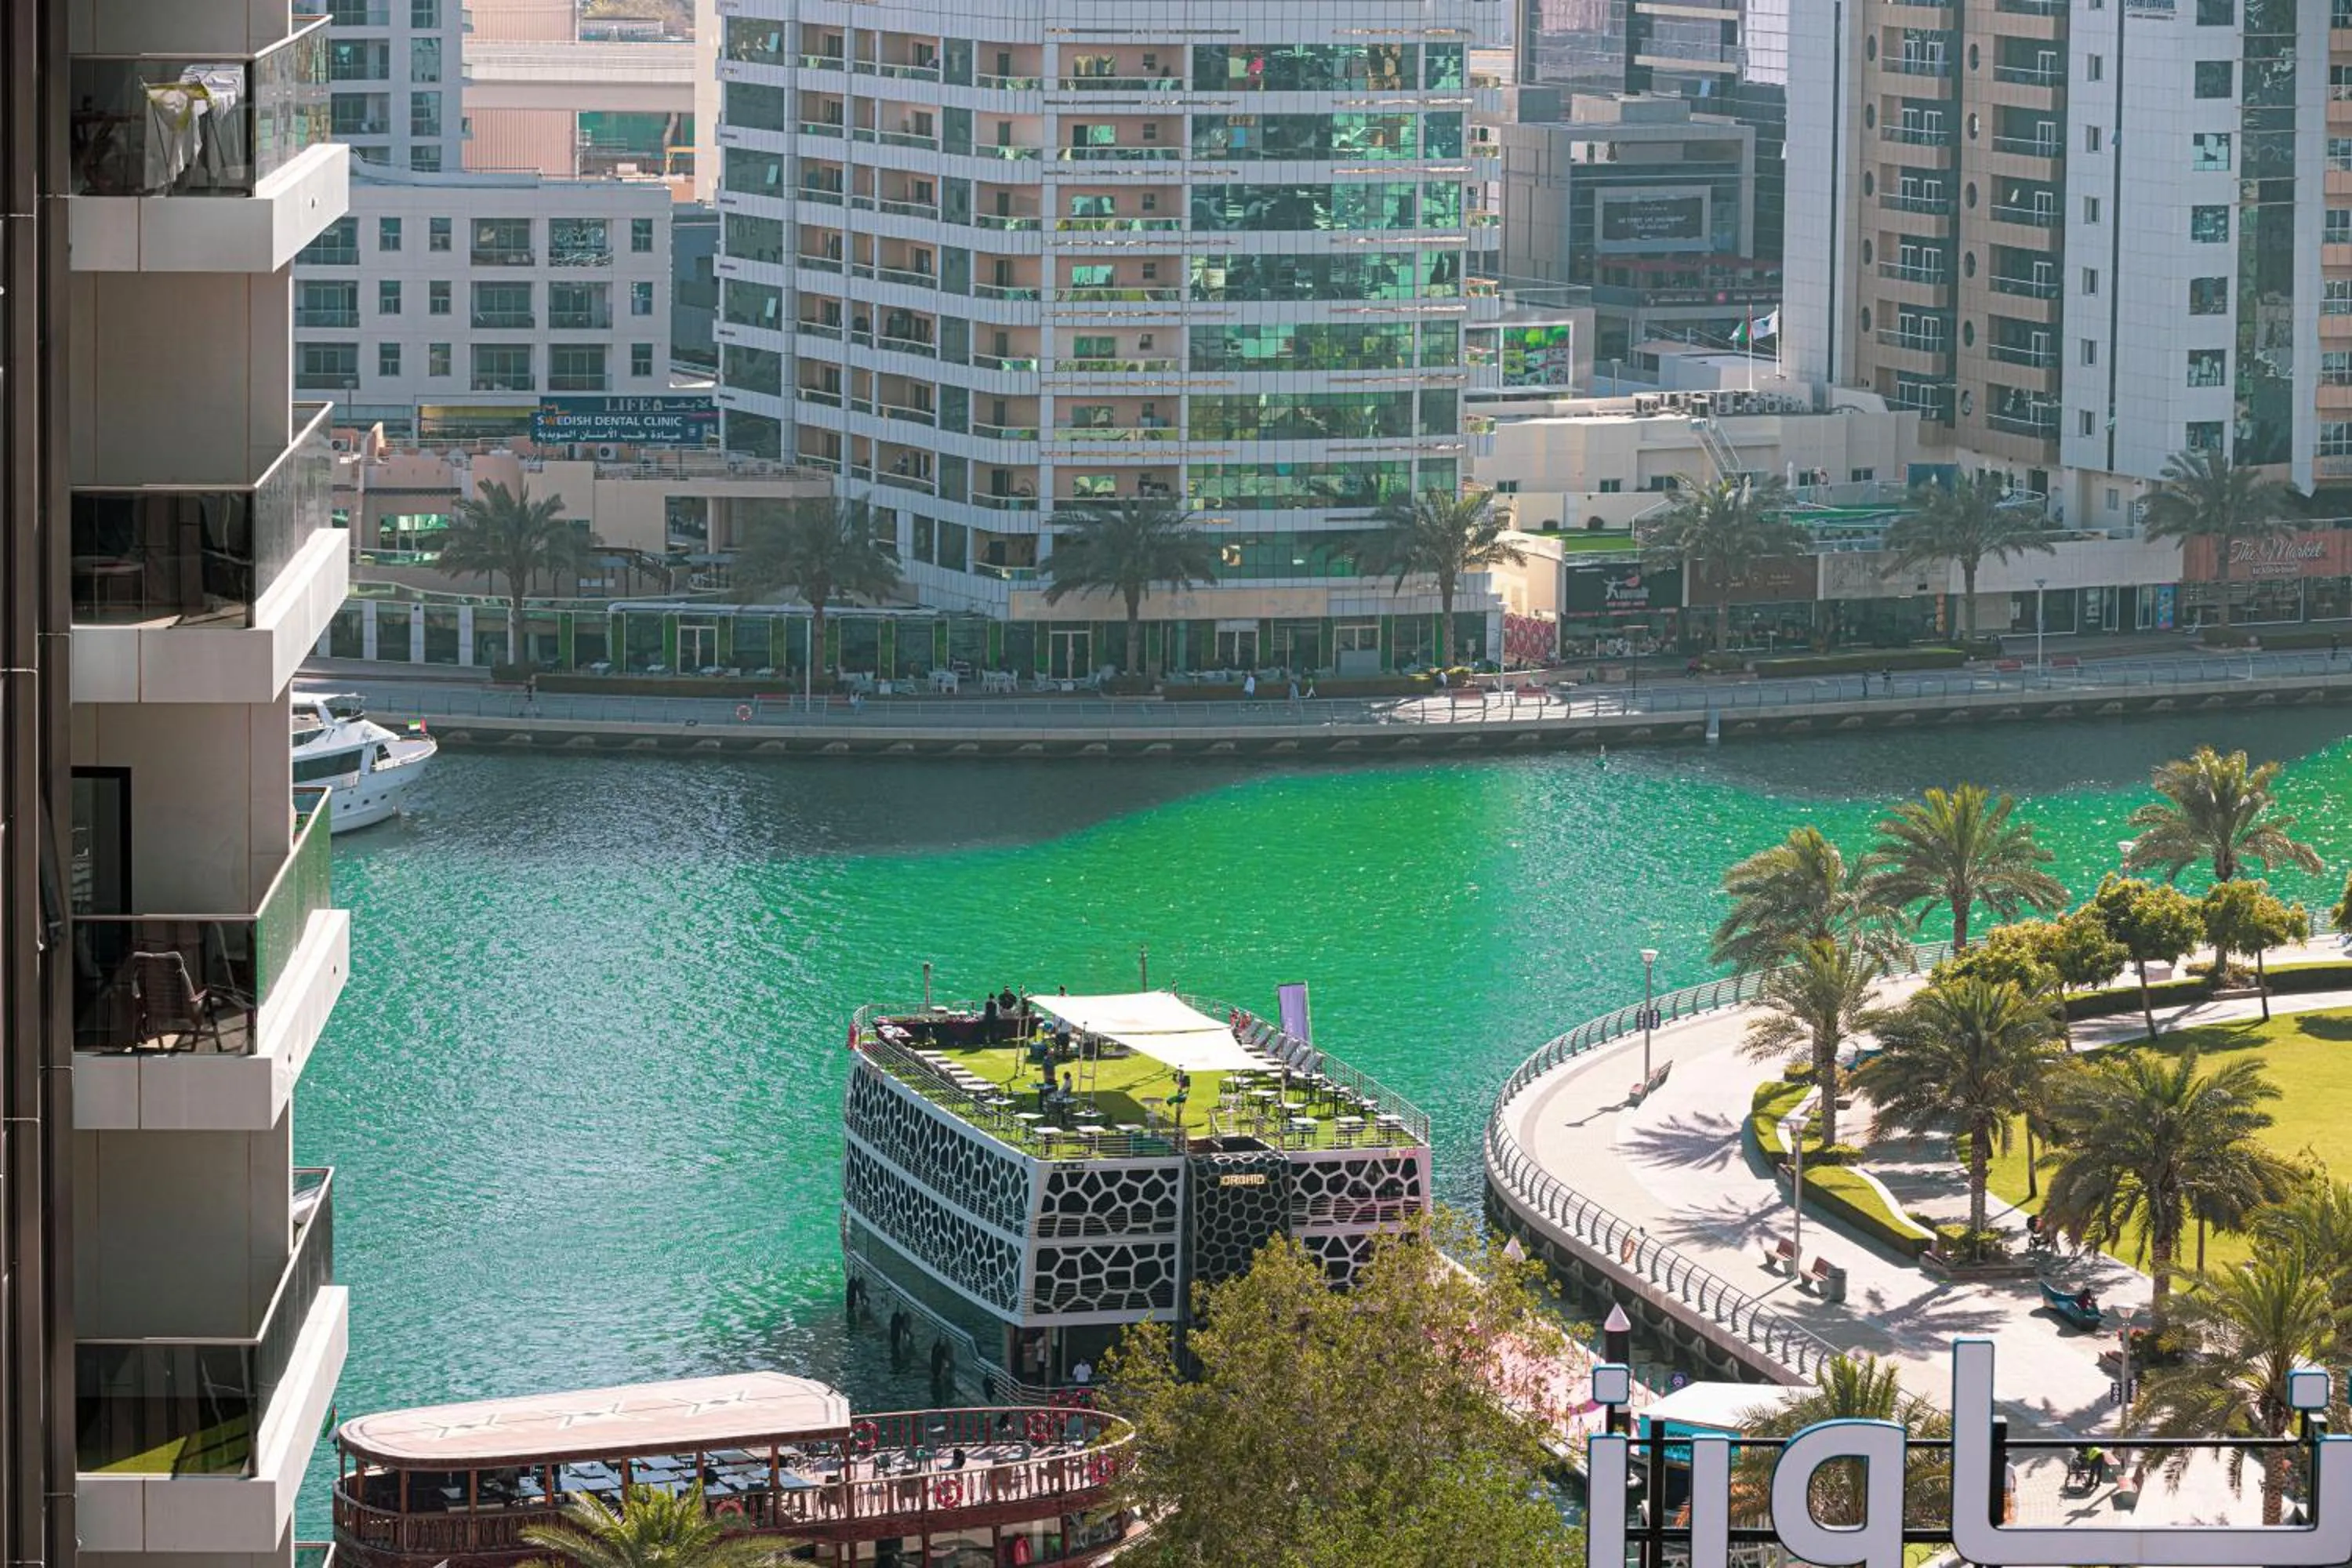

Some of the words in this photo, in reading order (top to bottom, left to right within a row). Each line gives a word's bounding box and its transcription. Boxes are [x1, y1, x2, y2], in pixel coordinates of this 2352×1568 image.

[604, 397, 652, 412] LIFE
[536, 416, 592, 426] SWEDISH
[593, 416, 641, 426] DENTAL
[643, 416, 682, 426] CLINIC
[2229, 539, 2256, 564] The
